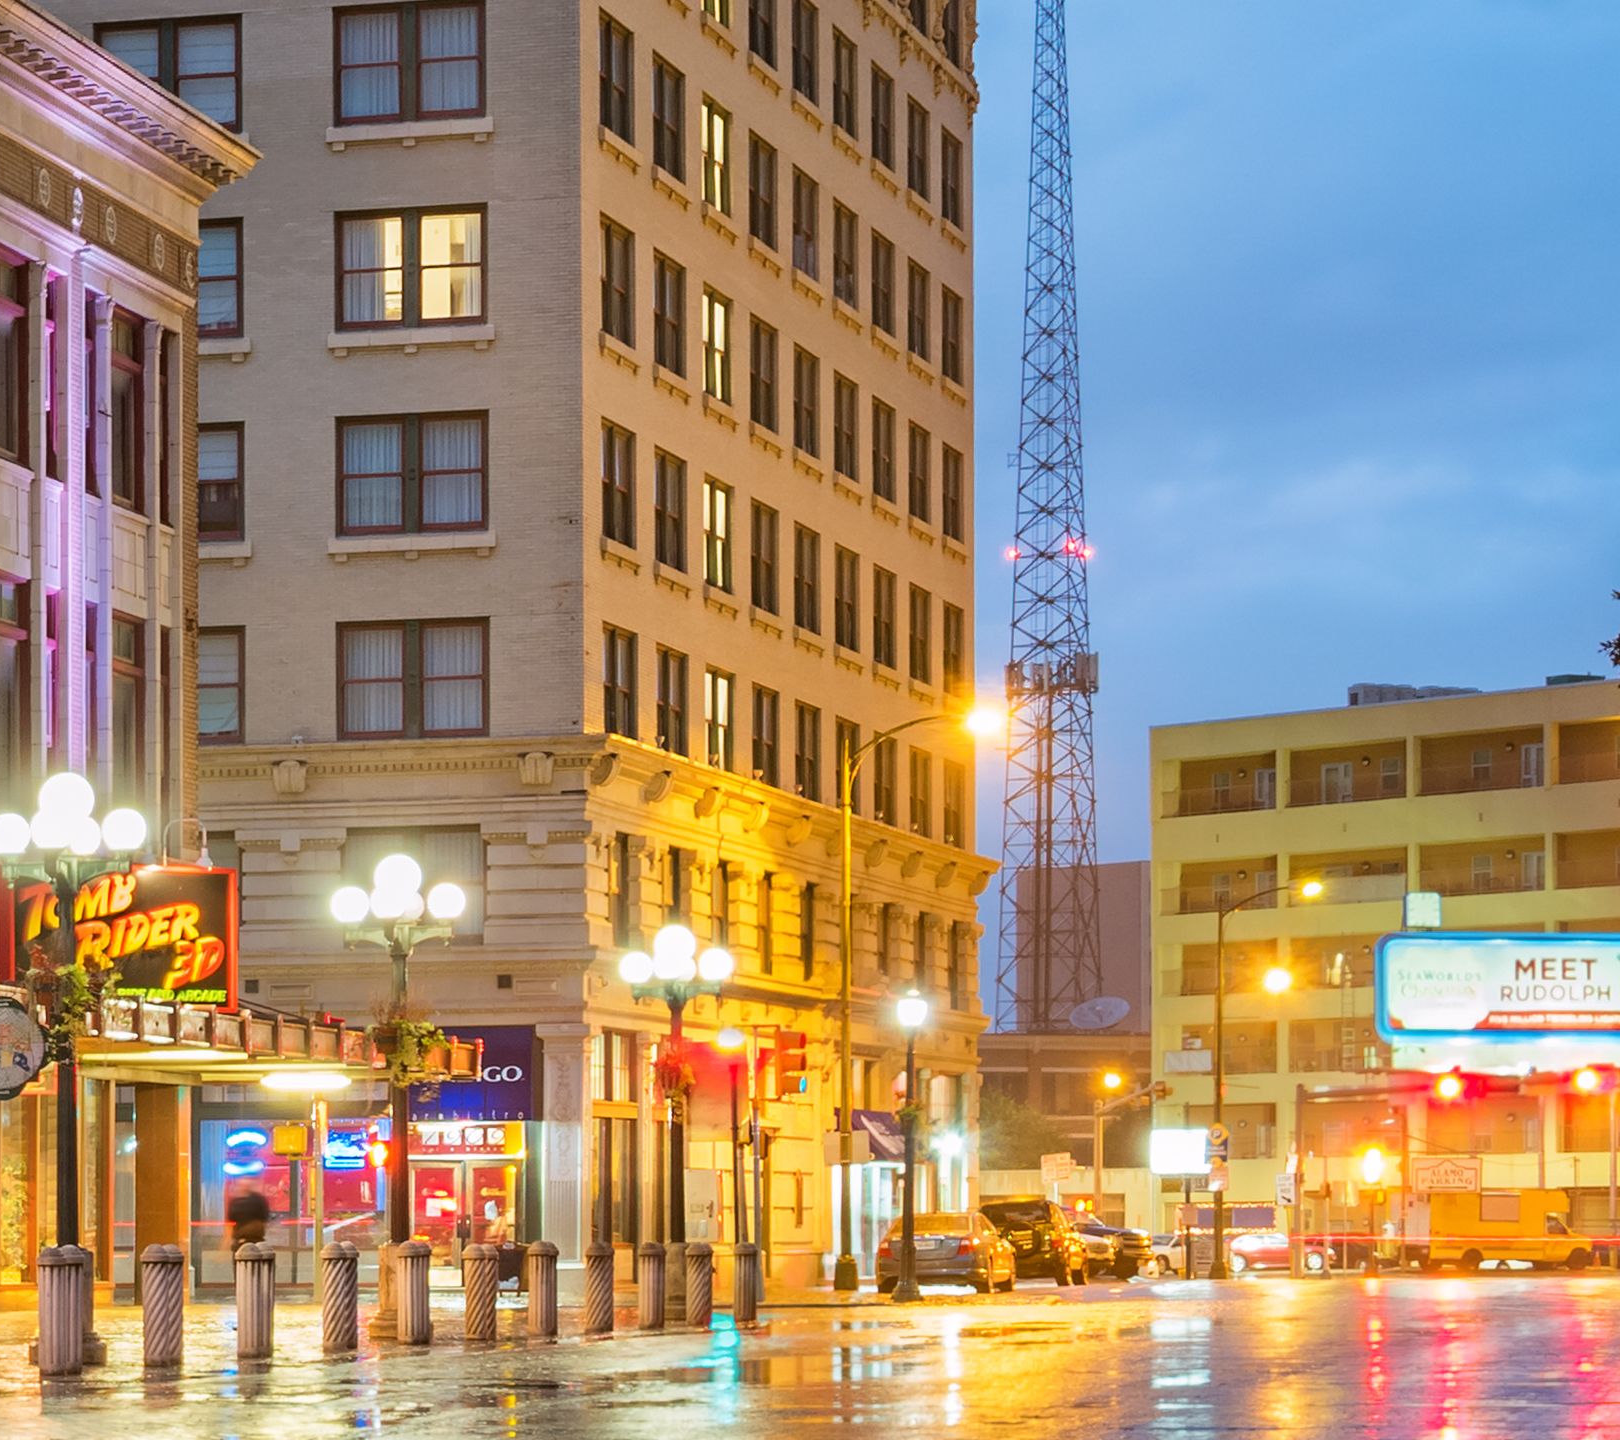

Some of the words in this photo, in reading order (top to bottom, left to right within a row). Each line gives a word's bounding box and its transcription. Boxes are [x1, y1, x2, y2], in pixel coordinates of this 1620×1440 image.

[75, 902, 200, 970] RIDER
[164, 936, 225, 990] 3D
[1515, 959, 1598, 980] MEET
[176, 990, 227, 1002] ARCADE
[1500, 985, 1611, 1001] RUDOLPH
